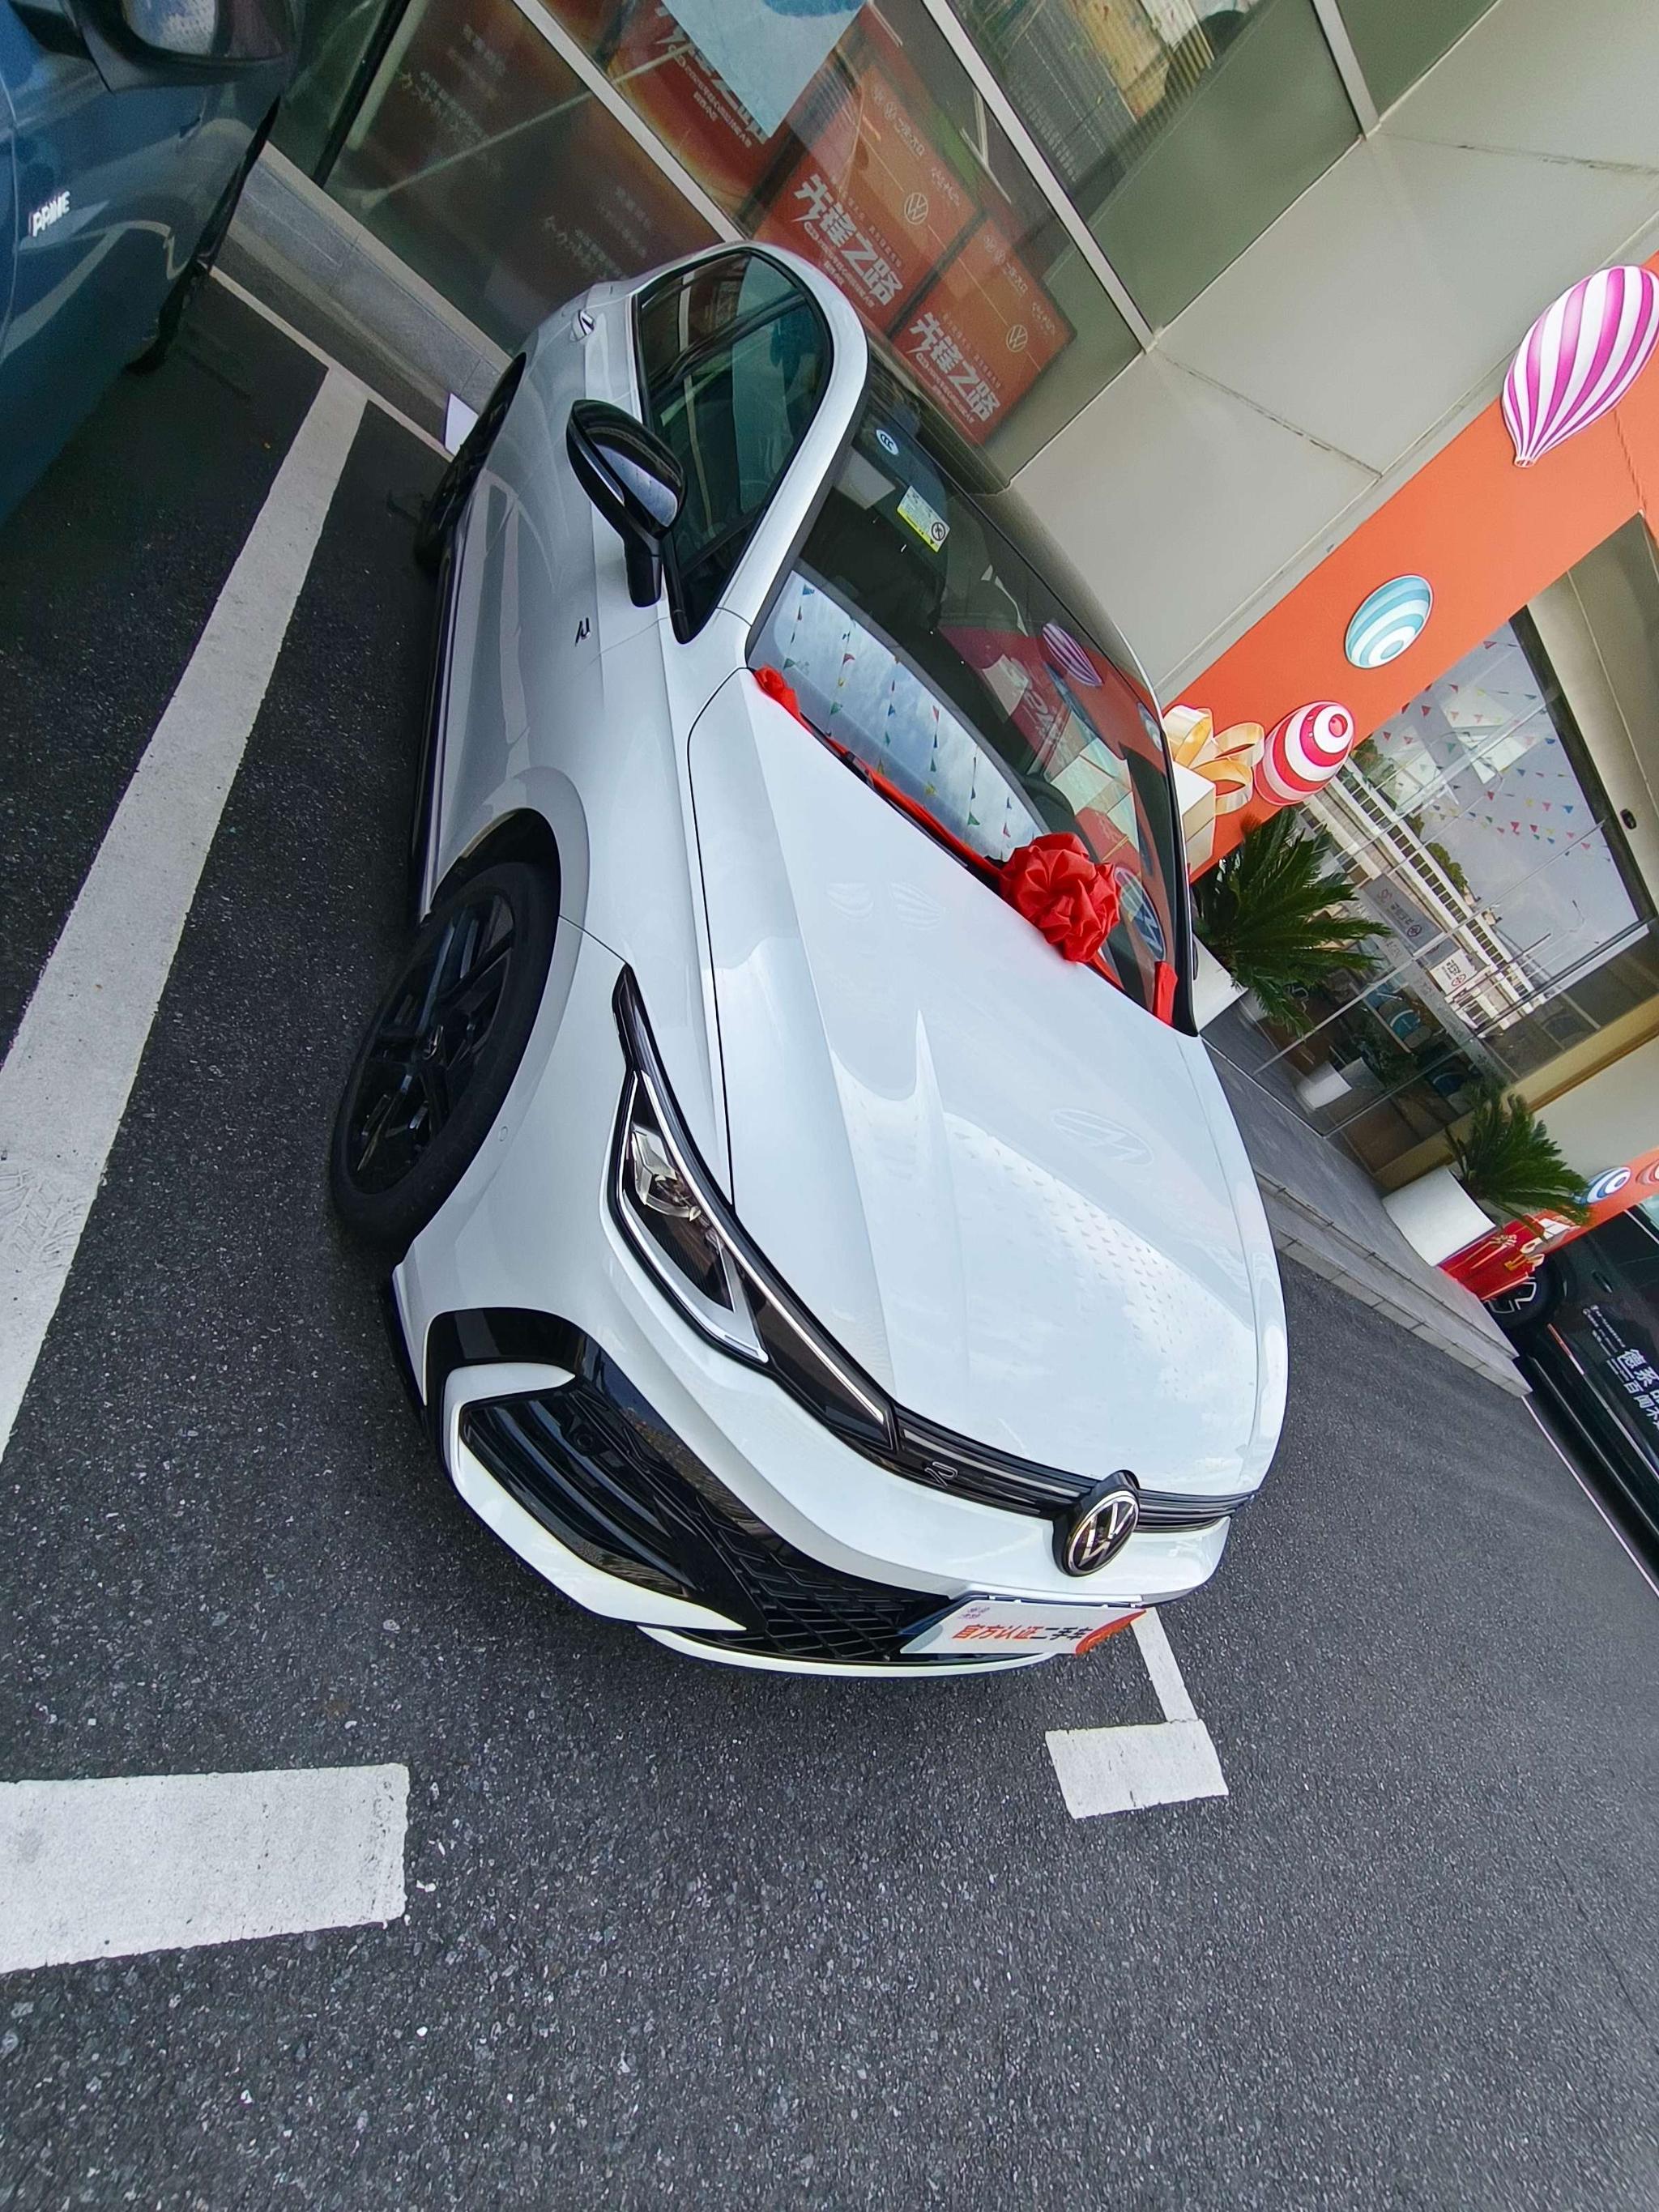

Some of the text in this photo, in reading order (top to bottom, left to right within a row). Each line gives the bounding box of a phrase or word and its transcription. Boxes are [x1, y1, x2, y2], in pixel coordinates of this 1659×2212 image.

[791, 173, 903, 306] 先锋之路
[906, 312, 1001, 423] 先锋之路
[951, 1623, 1094, 1641] 官方认证二手车
